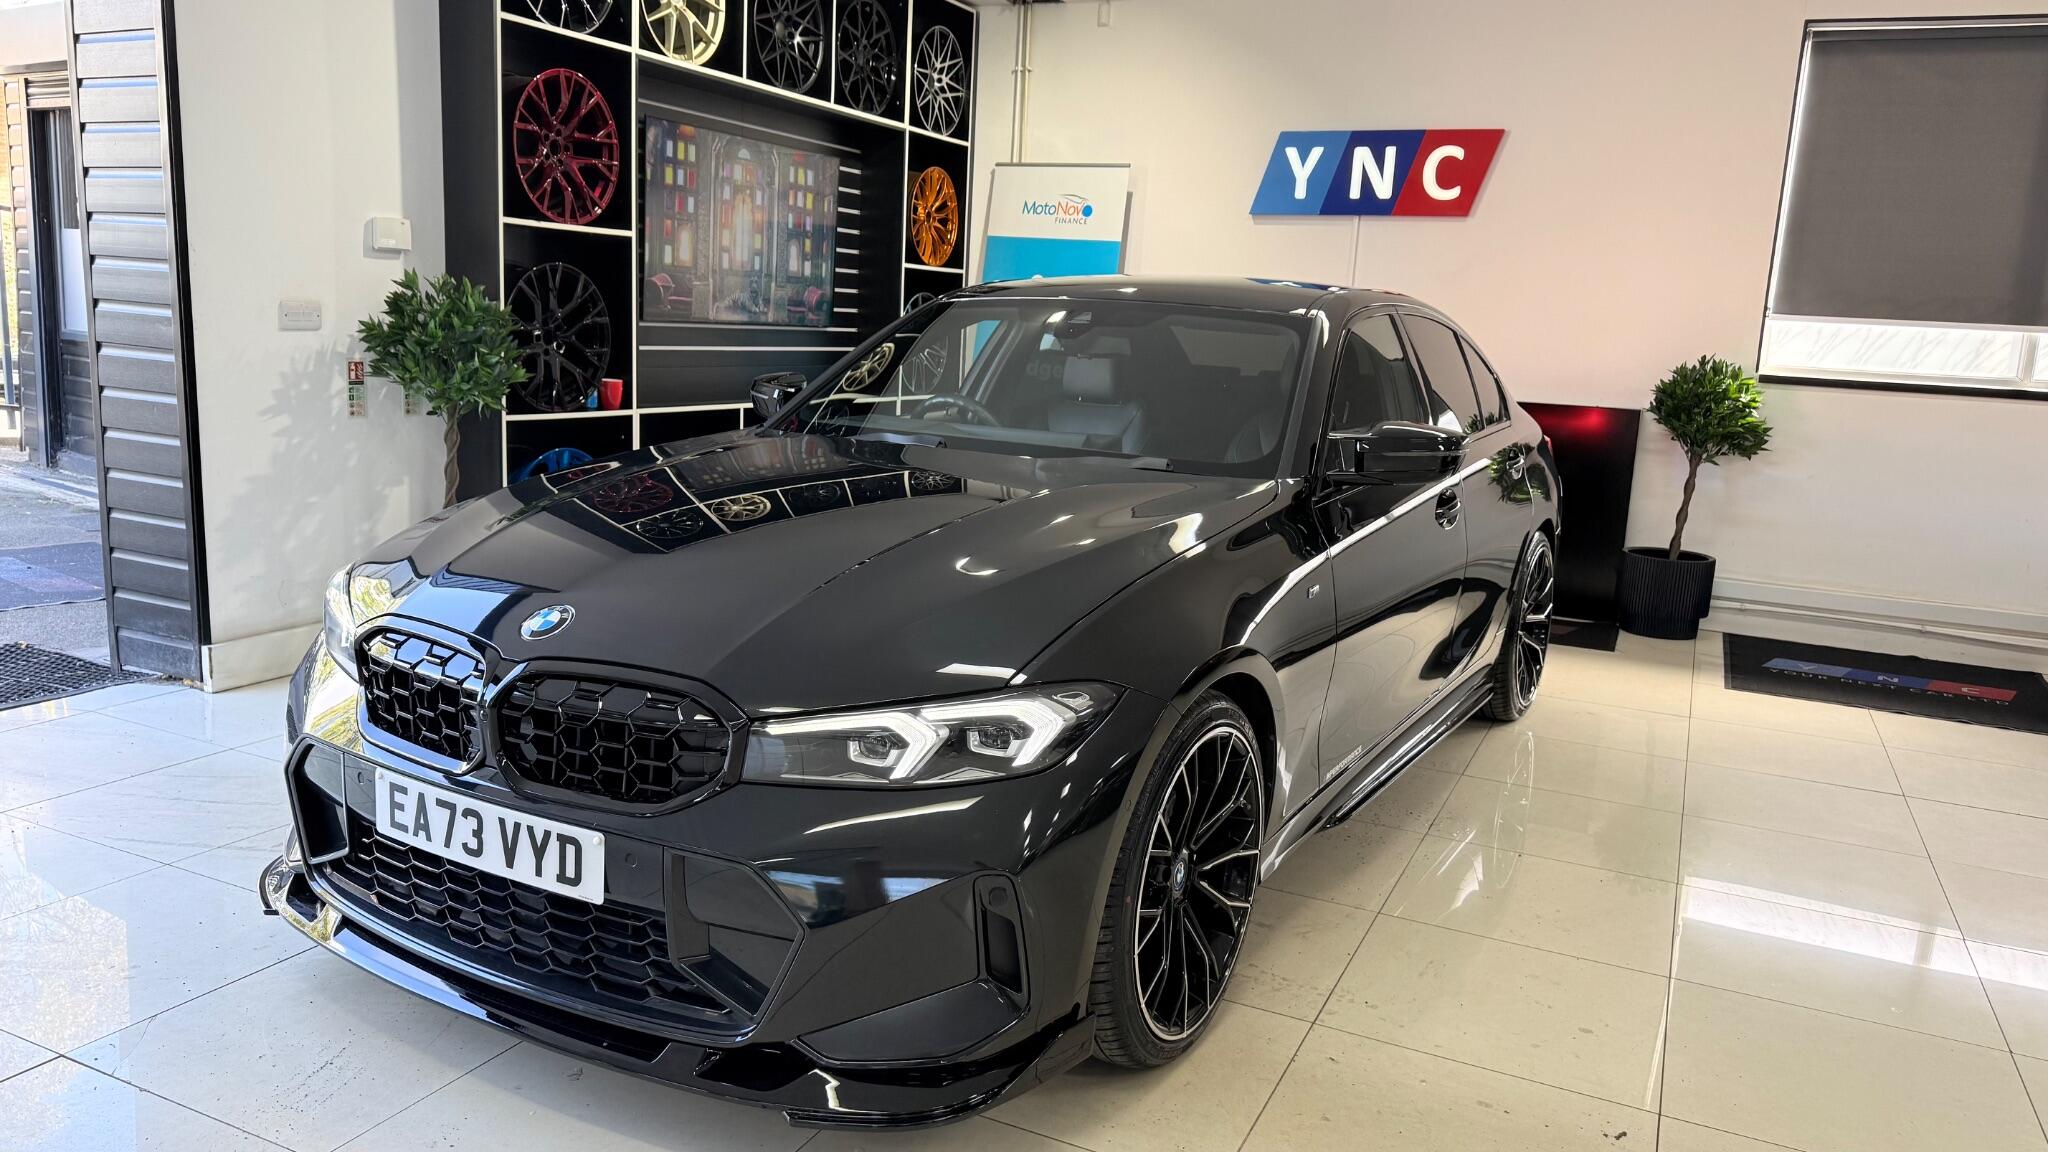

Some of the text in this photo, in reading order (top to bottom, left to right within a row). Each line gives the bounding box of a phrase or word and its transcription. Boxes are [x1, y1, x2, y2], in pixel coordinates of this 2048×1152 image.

[1285, 145, 1465, 201] YNC
[1054, 216, 1088, 225] FINANCE
[389, 781, 583, 888] EA73 VYD
